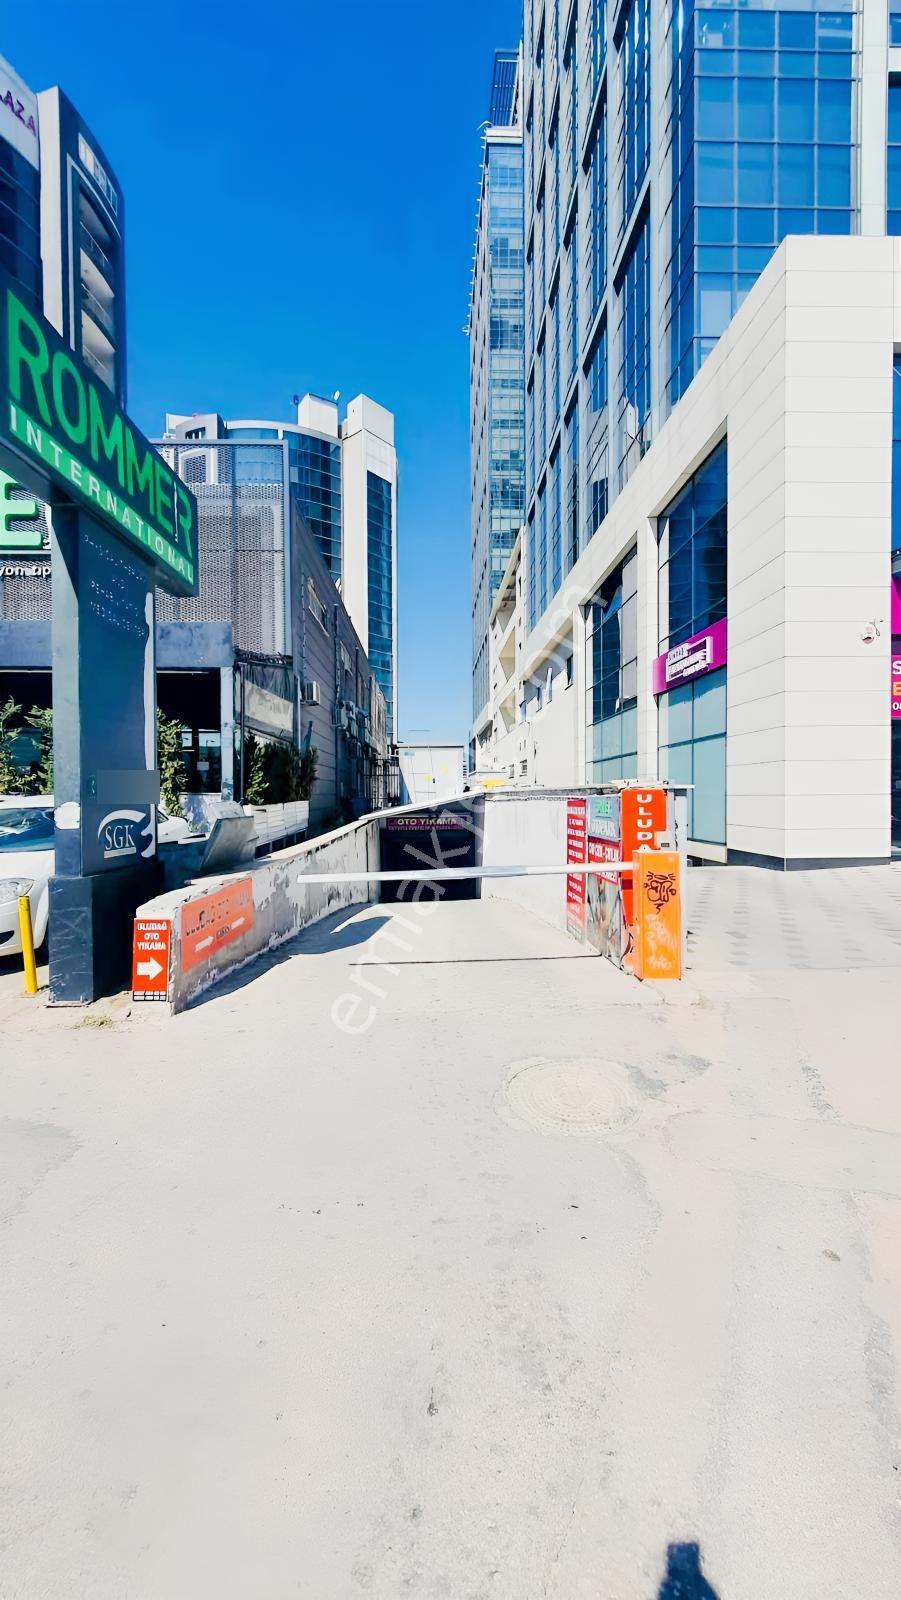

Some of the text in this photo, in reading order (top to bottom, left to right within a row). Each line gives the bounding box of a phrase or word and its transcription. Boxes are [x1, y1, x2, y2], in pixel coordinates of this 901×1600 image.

[0, 89, 37, 137] AZA
[6, 288, 194, 560] ROMMER
[9, 404, 195, 585] INTERNATIONAL
[105, 824, 135, 851] SGK
[144, 932, 160, 941] OTO
